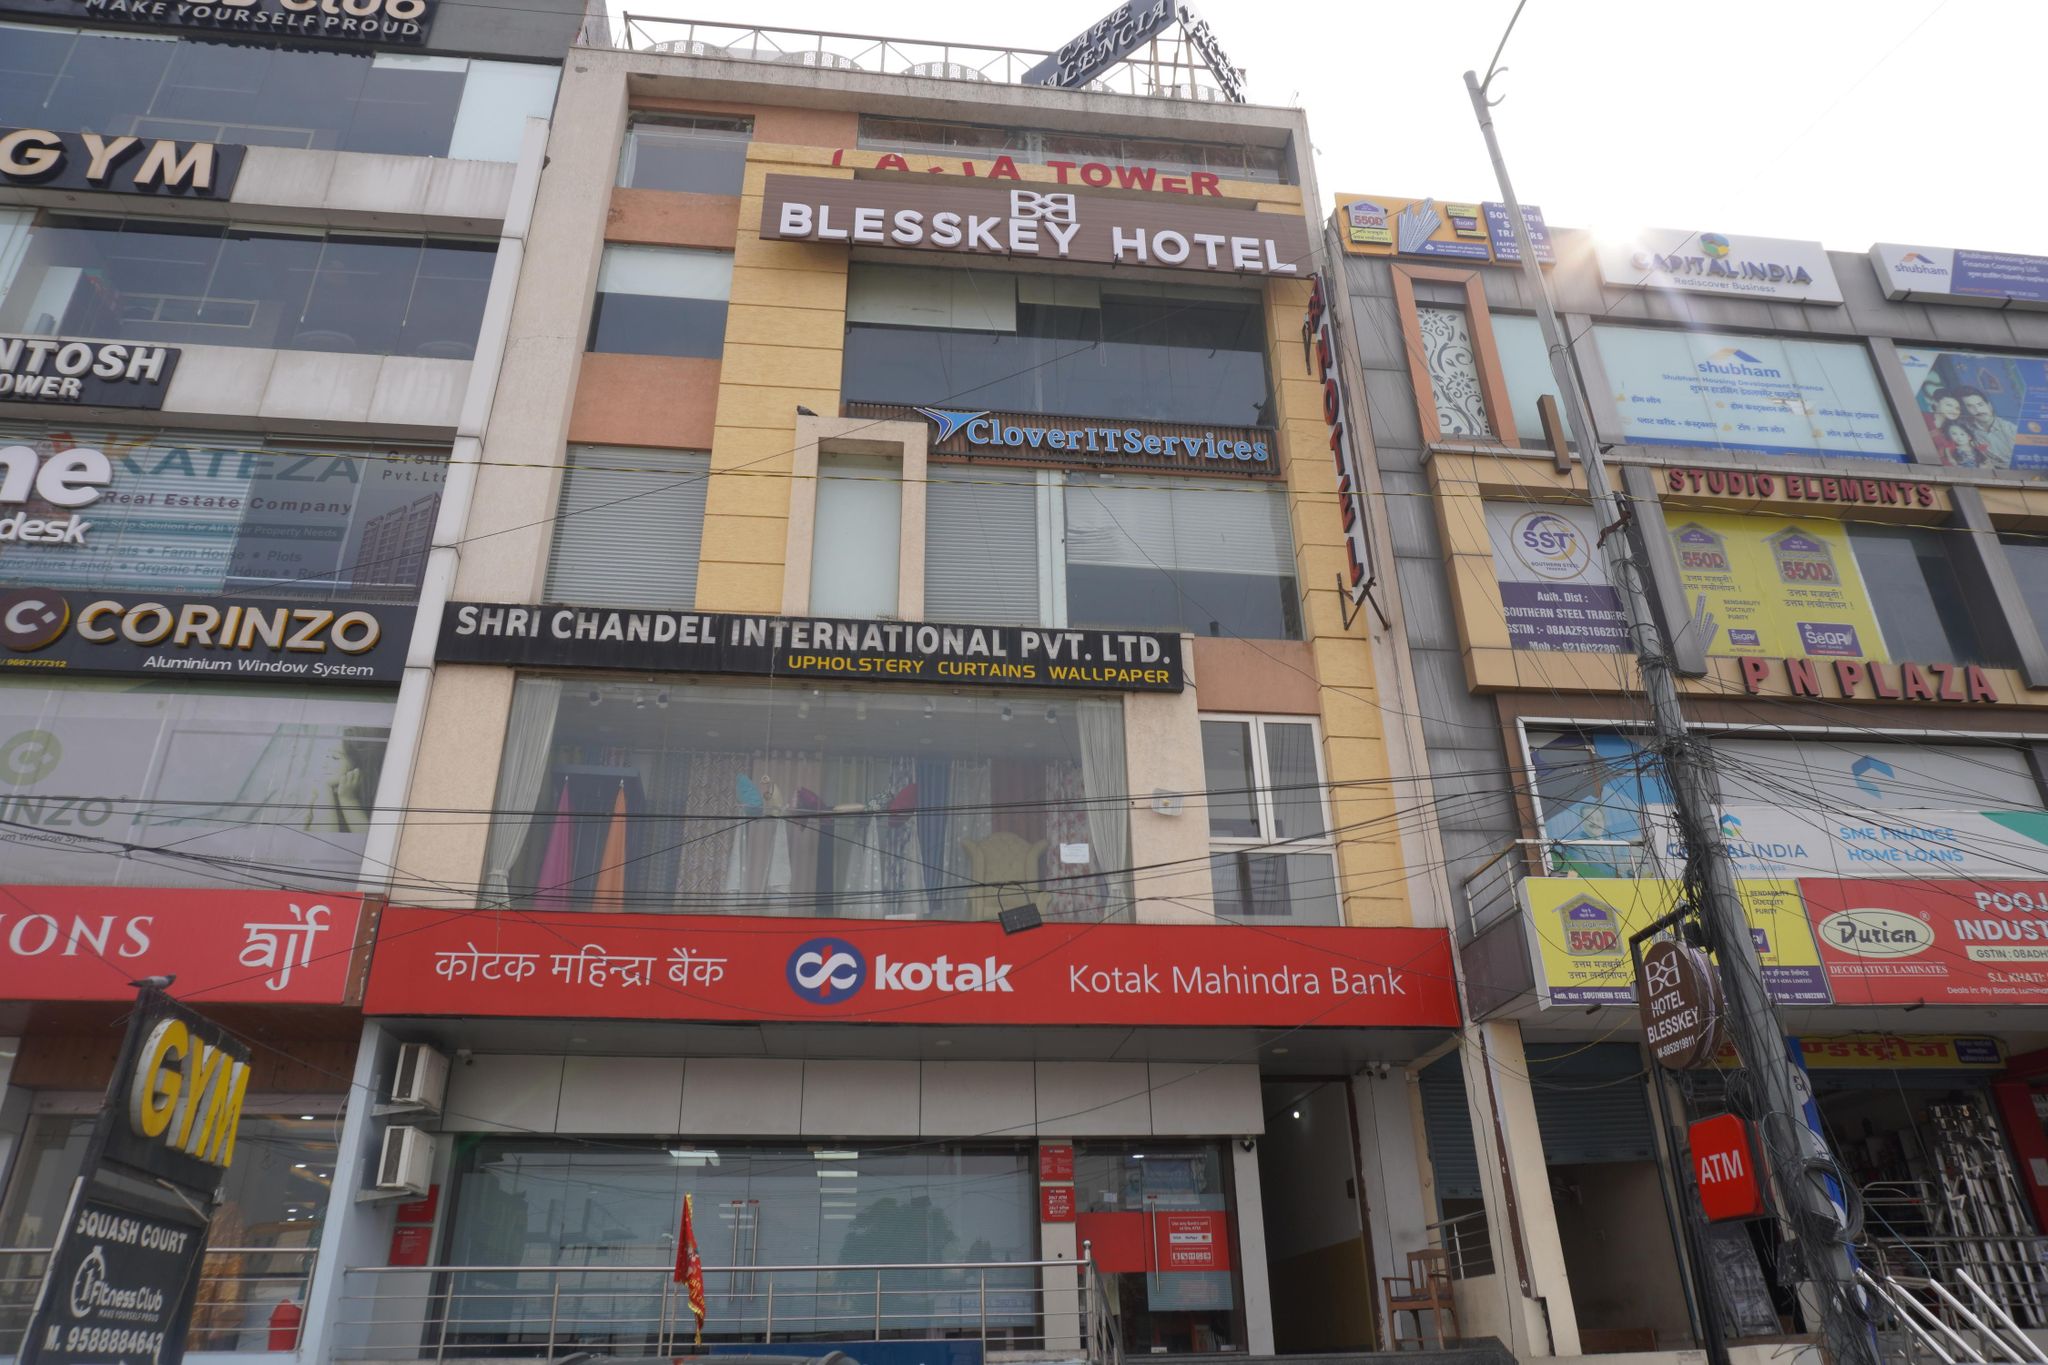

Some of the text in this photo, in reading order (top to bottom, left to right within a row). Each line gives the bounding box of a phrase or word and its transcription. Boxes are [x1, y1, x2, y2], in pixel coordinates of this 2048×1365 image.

[84, 0, 419, 35] MAKE YOURSELF PROUD
[1057, 4, 1130, 66] CAFE
[0, 129, 214, 189] GYM
[1046, 160, 1224, 198] TOWER
[779, 202, 1298, 274] BLESSKEY HOTEL
[1673, 276, 1775, 293] Rediscover Business
[1895, 263, 1949, 276] shubham
[1699, 361, 1781, 379] shubham
[966, 419, 1270, 462] CloverITServices
[103, 432, 361, 485] KATEZA
[1316, 324, 1365, 588] HOTEL
[1668, 467, 1934, 507] STUDIO ELEMENTS
[102, 491, 352, 516] Real Estate Company
[253, 525, 301, 541] Property
[304, 527, 338, 539] Needs
[1523, 531, 1569, 549] SST
[266, 550, 303, 563] Plots
[1681, 551, 1725, 569] 550D
[1782, 560, 1833, 582] 550D
[1537, 591, 1583, 602] Auth. Dist
[76, 599, 381, 655] CORINZO
[1504, 606, 1554, 618] SOUTHERN
[1556, 609, 1585, 619] STEEL
[455, 605, 1171, 665] SHRI CHANDEL INTERNATIONAL PVT. LTD.
[142, 655, 375, 679] Aluminium Window System
[788, 654, 1169, 684] UPHOLSTERY CURTAINS WALLPAPER
[1737, 656, 2000, 705] P N PLAZA
[1840, 827, 1958, 843] SME FINANCE
[1847, 848, 1964, 864] HOME LOANS
[0, 913, 154, 958] ONS
[1569, 930, 1617, 951] 550D
[1837, 920, 1918, 944] Durian
[434, 942, 728, 988] कोटक महिन्द्रा बैंक
[1976, 950, 2007, 959] GSTIN
[875, 952, 1014, 993] kotak
[1069, 964, 1407, 996] Kotak Mahindra Bank
[1829, 964, 1949, 976] DECORATIVE LAMINATES
[1651, 990, 1685, 1018] HOTEL
[1947, 986, 1968, 995] Deals
[1647, 1006, 1699, 1044] BLESSKEY
[131, 1018, 251, 1168] GYM
[1701, 1149, 1745, 1185] ATM
[77, 1209, 188, 1255] SQUASH COURT
